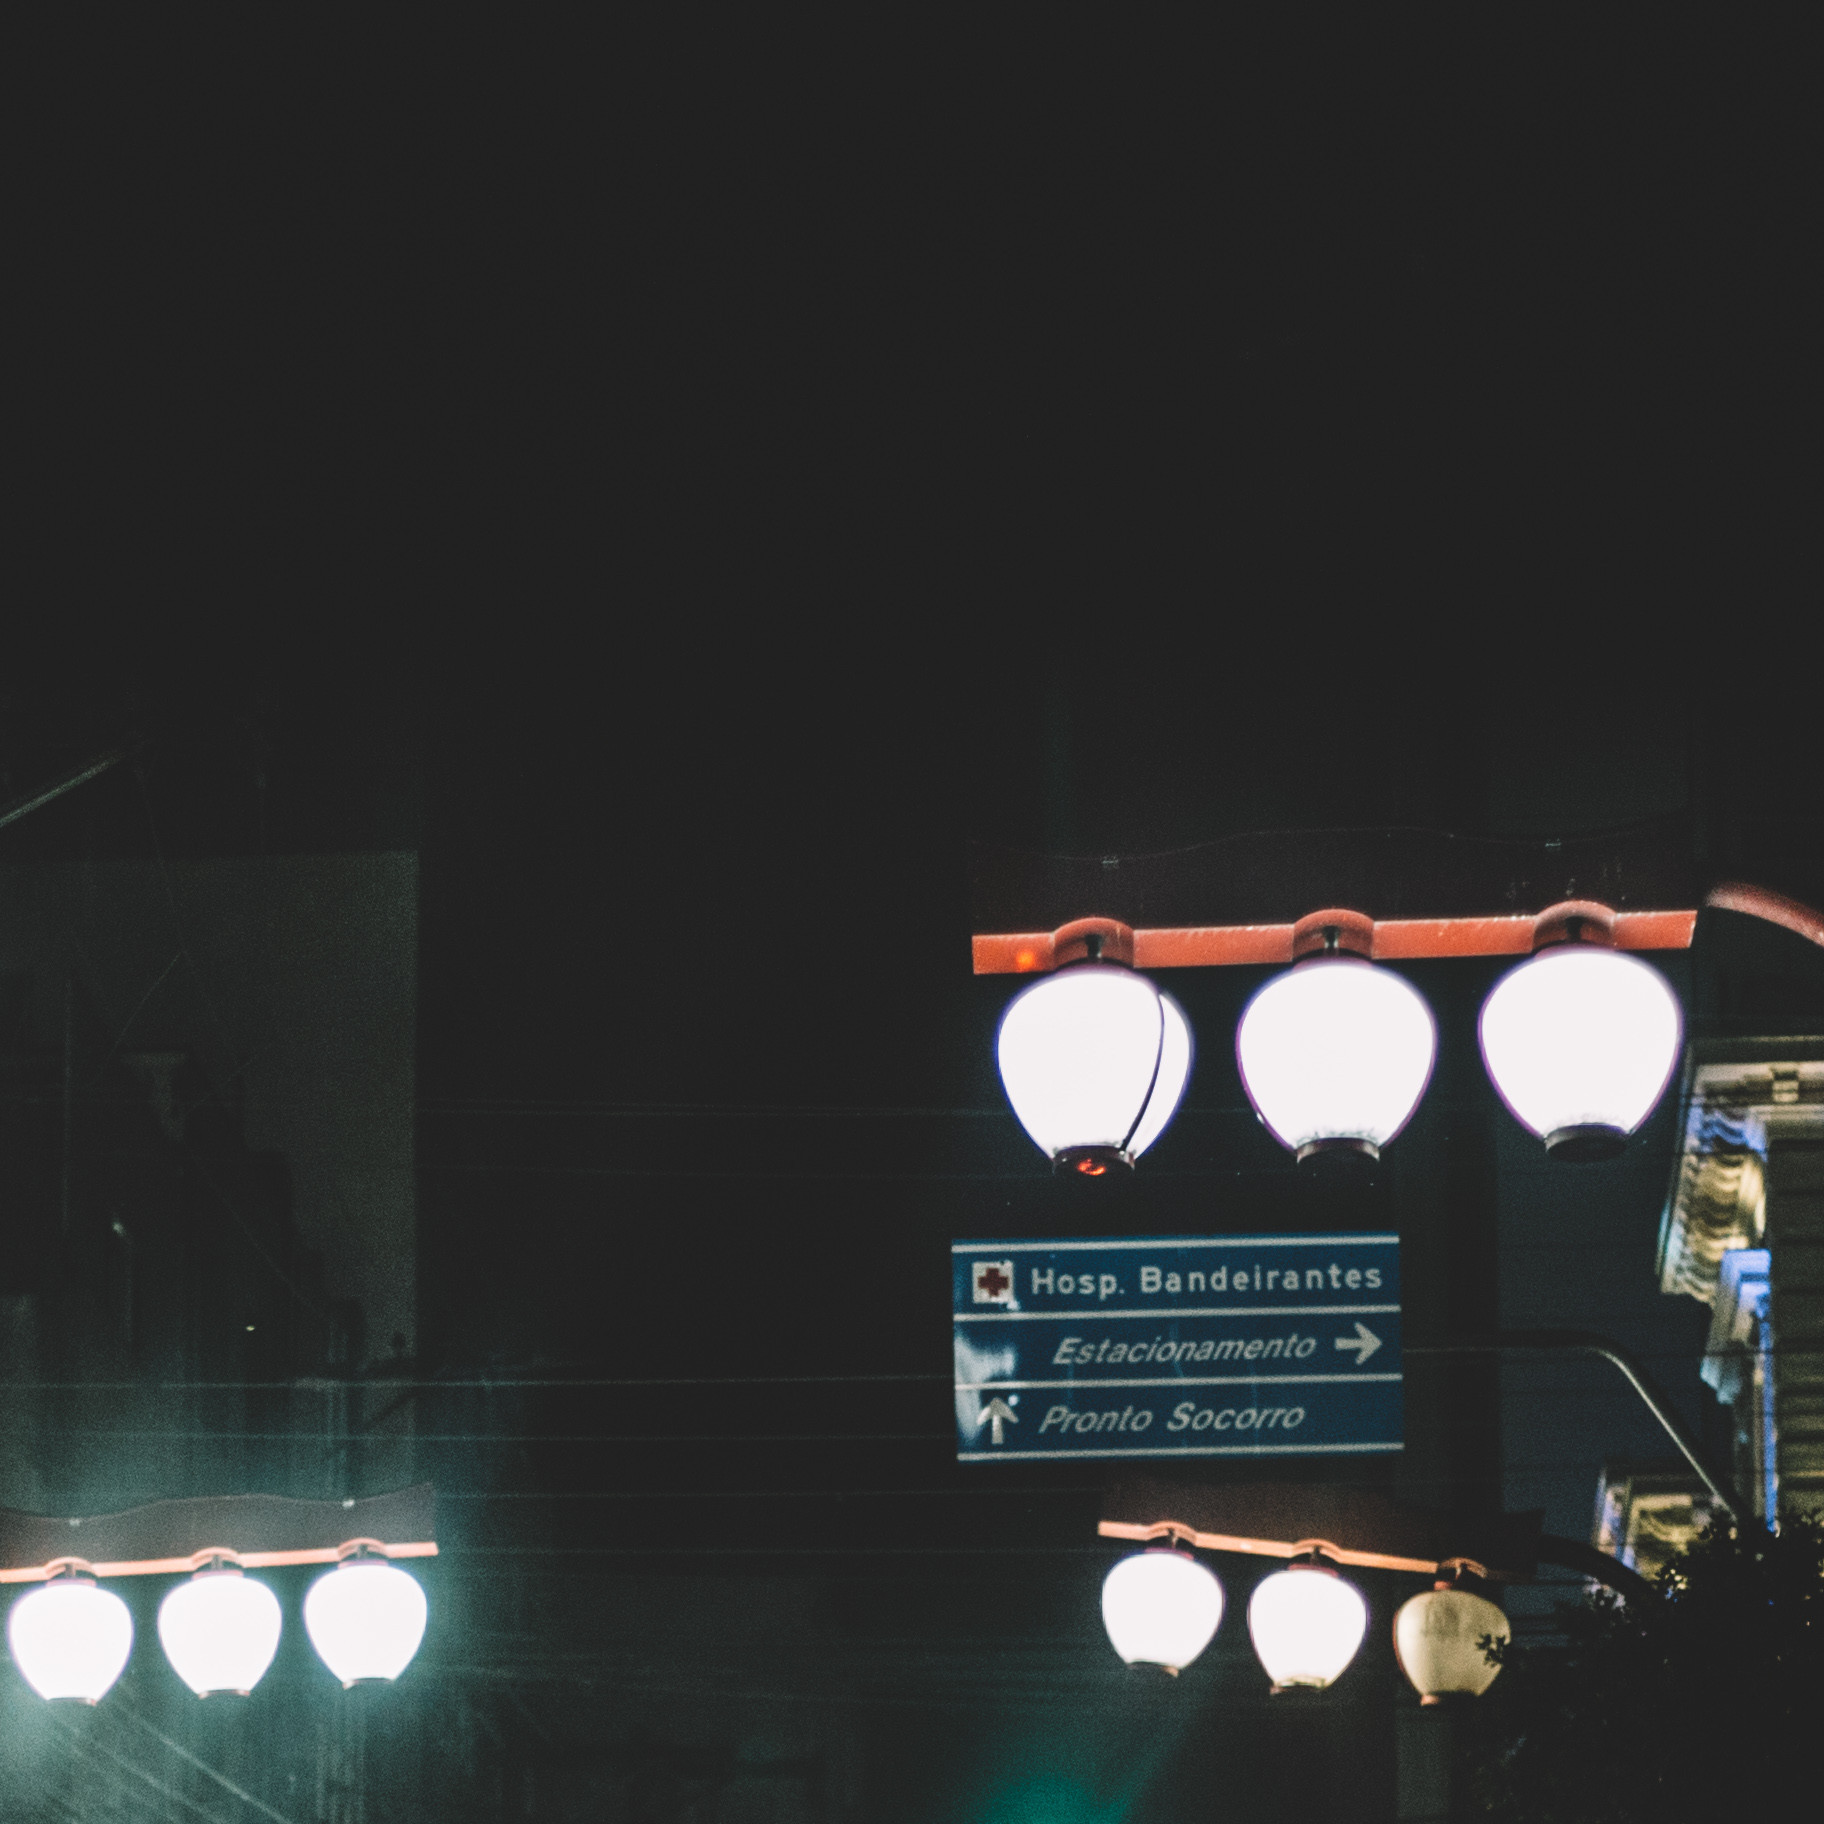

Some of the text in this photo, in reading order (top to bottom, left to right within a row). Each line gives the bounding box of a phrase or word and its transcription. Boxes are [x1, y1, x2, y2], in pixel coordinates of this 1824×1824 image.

[1031, 1263, 1383, 1301] Hosp. Bandeirantes
[1052, 1333, 1317, 1366] Estacionamento
[1038, 1401, 1306, 1434] Pronto Socorro
